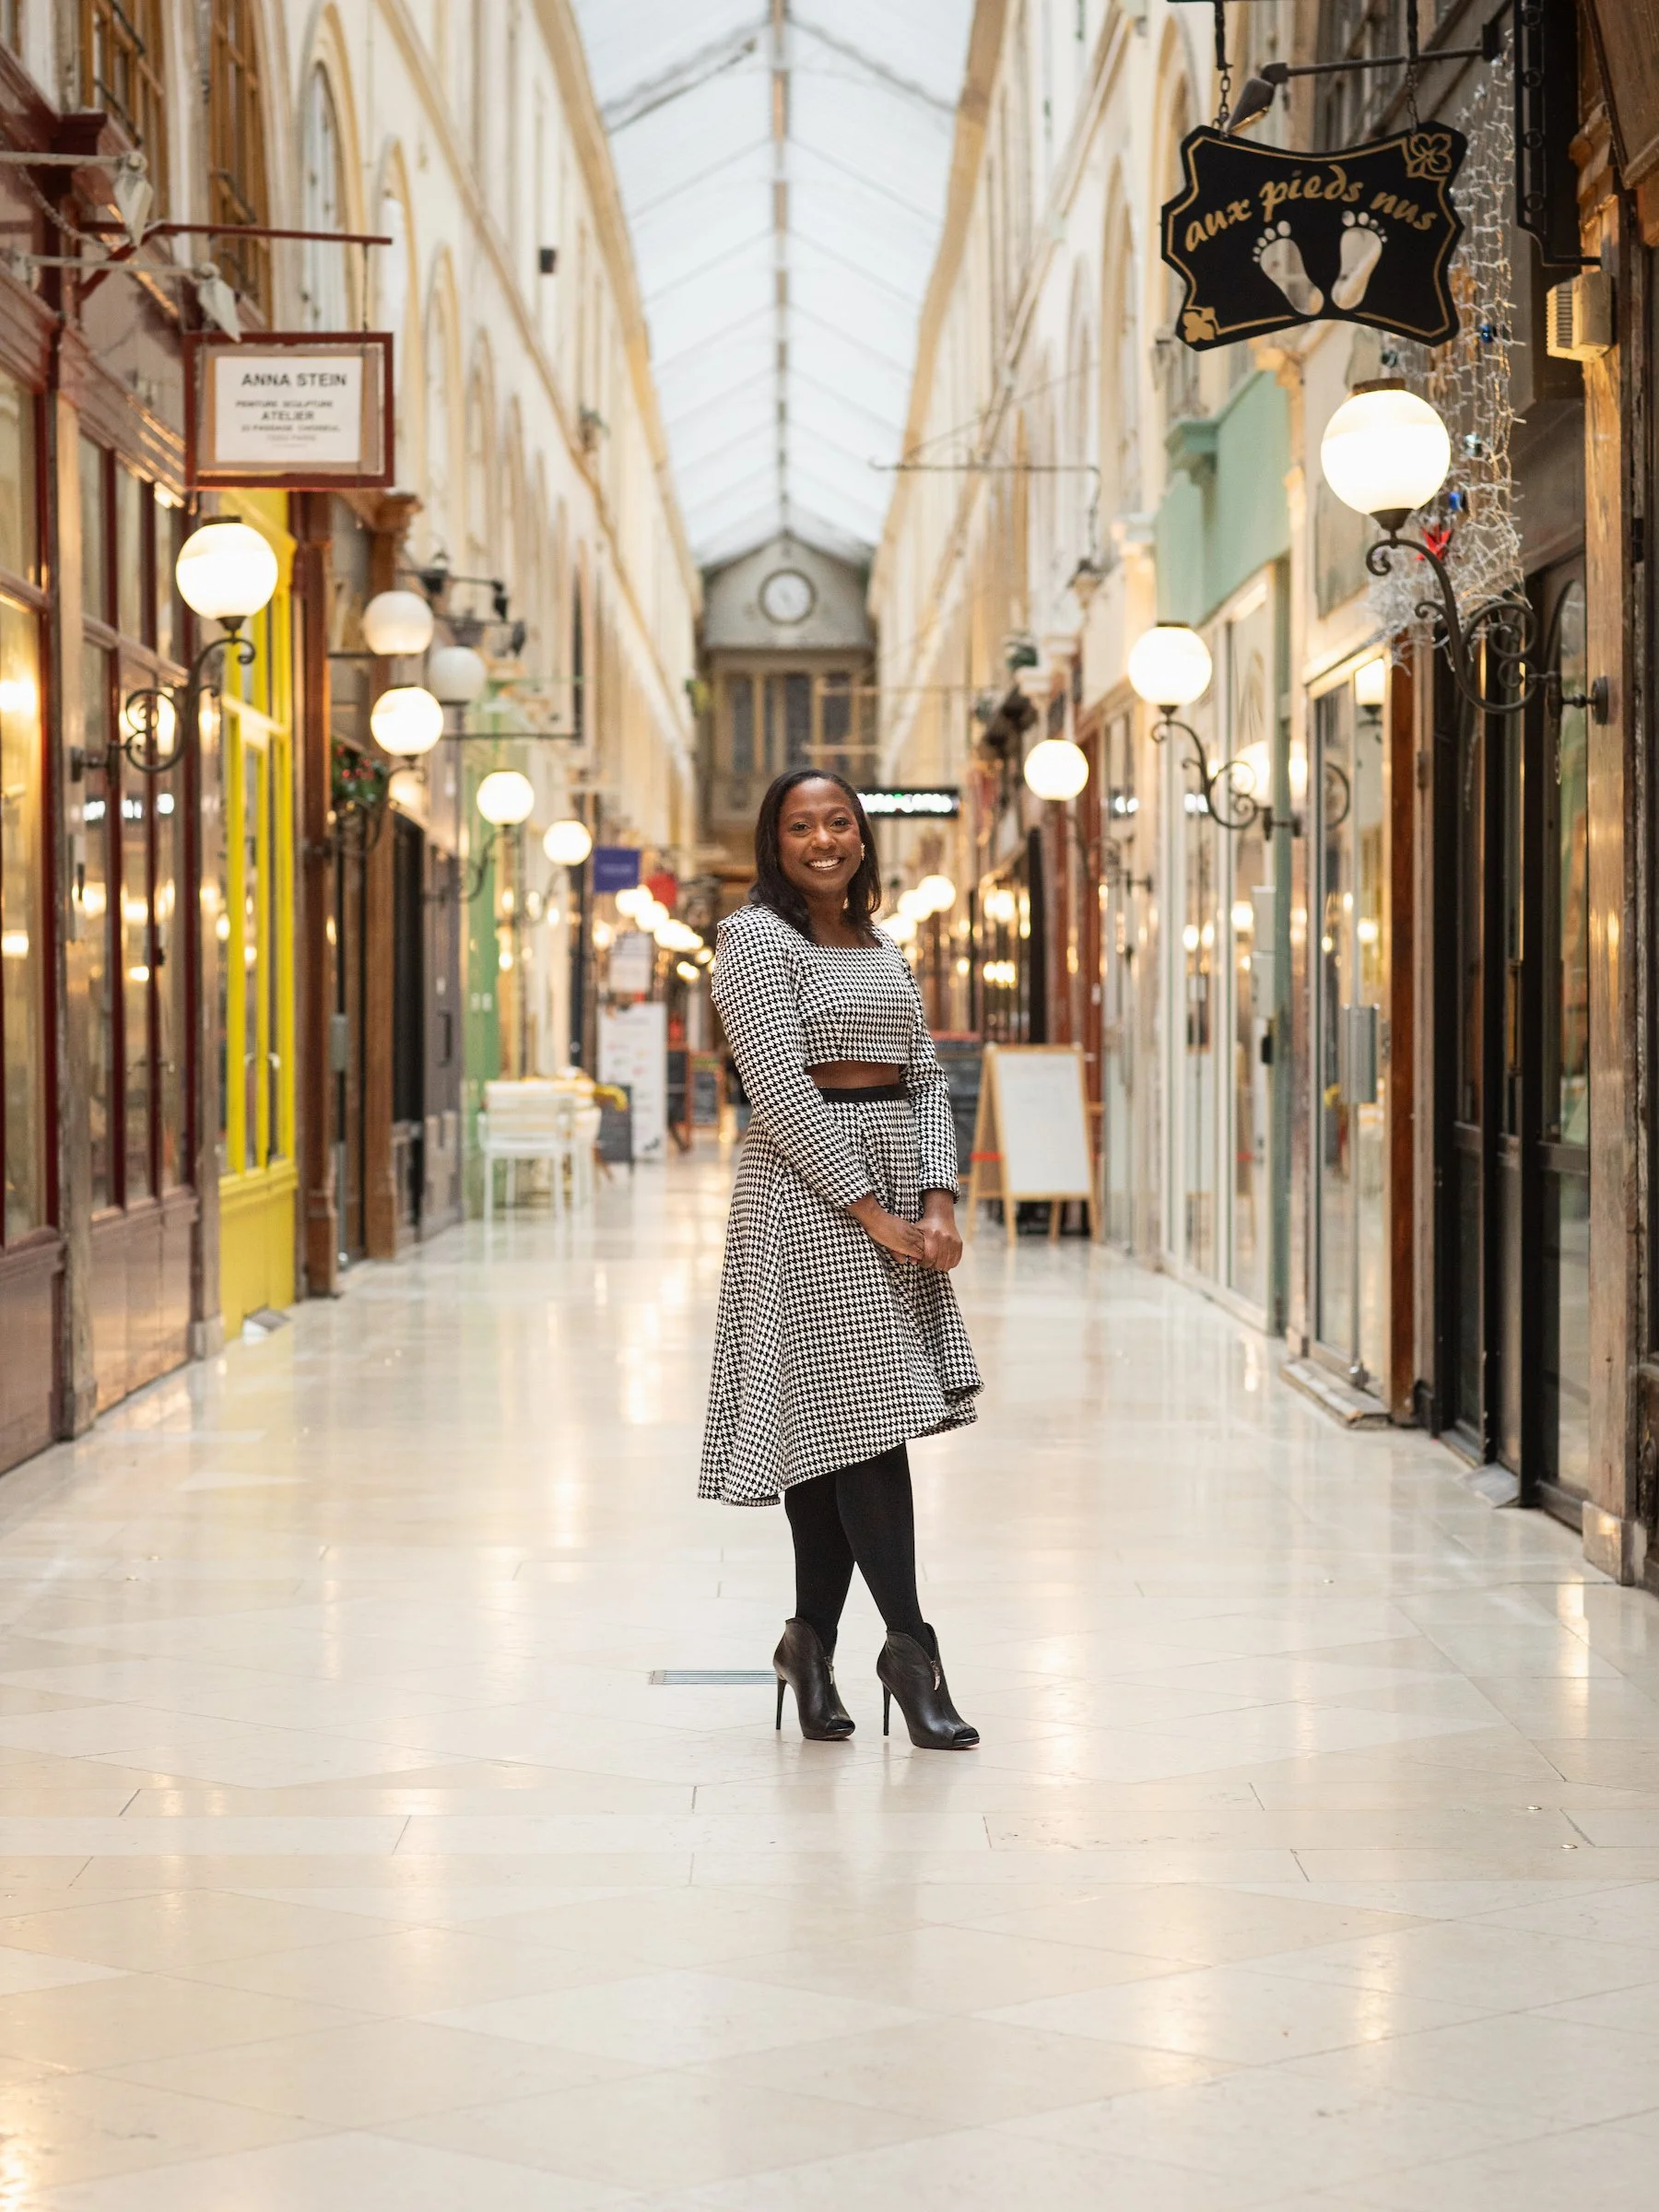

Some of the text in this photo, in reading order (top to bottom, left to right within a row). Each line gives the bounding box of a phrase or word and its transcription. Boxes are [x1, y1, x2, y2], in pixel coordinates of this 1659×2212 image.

[1185, 164, 1438, 253] aux pieds nus
[241, 373, 347, 387] ANNA STEIN
[261, 411, 314, 421] ATELIER
